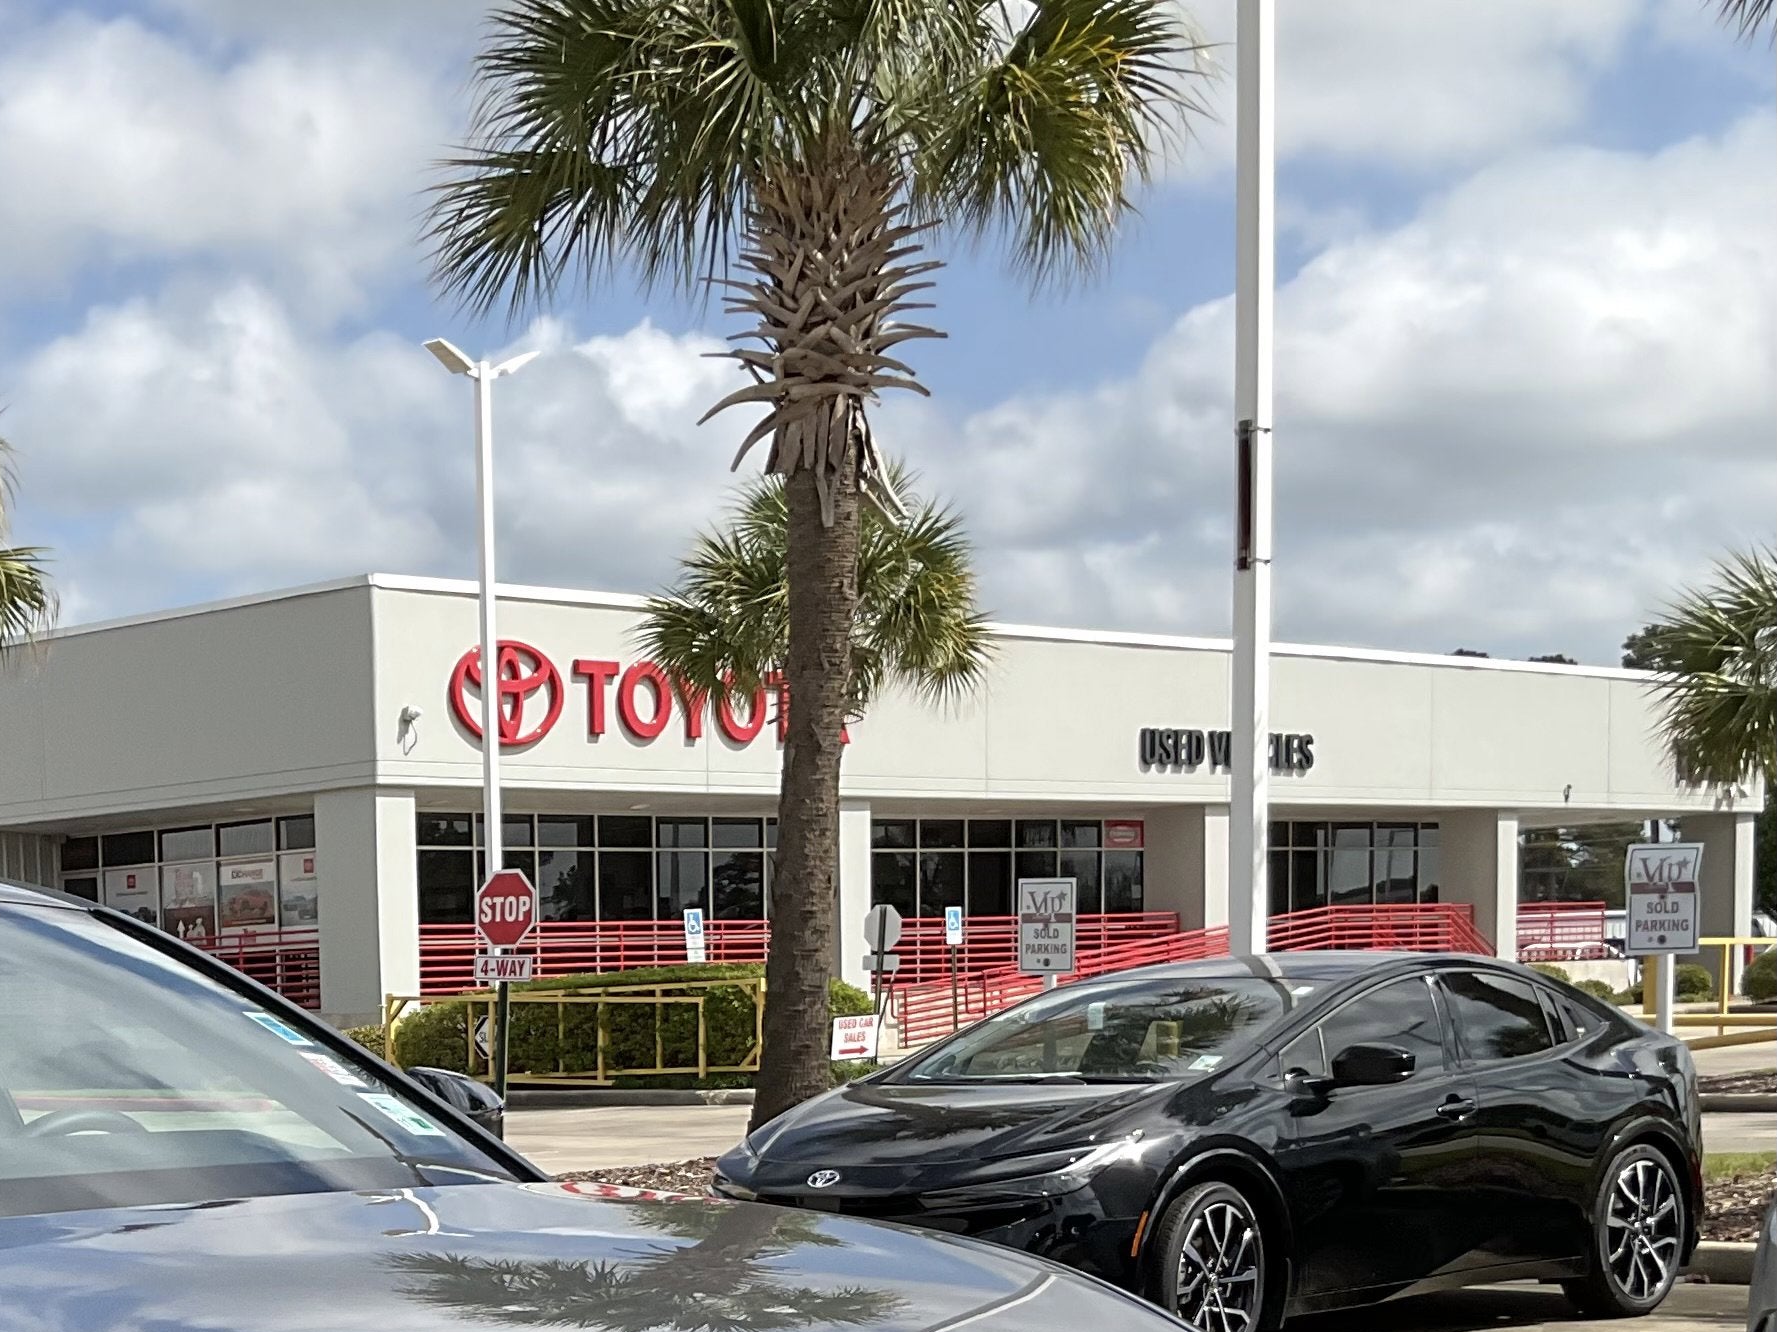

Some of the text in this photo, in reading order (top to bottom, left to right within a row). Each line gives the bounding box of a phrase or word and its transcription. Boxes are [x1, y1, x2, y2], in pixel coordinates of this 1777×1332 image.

[573, 658, 852, 745] TOYO
[1139, 728, 1314, 770] USED VLES
[480, 895, 530, 924] STOP
[1646, 901, 1680, 914] SOLD
[1634, 918, 1690, 933] PARKING
[1033, 927, 1060, 940] SOLD
[1025, 943, 1068, 955] PARKING
[480, 959, 526, 977] 4-WAY
[838, 1017, 874, 1030] USED CAR
[844, 1031, 866, 1043] SALES
